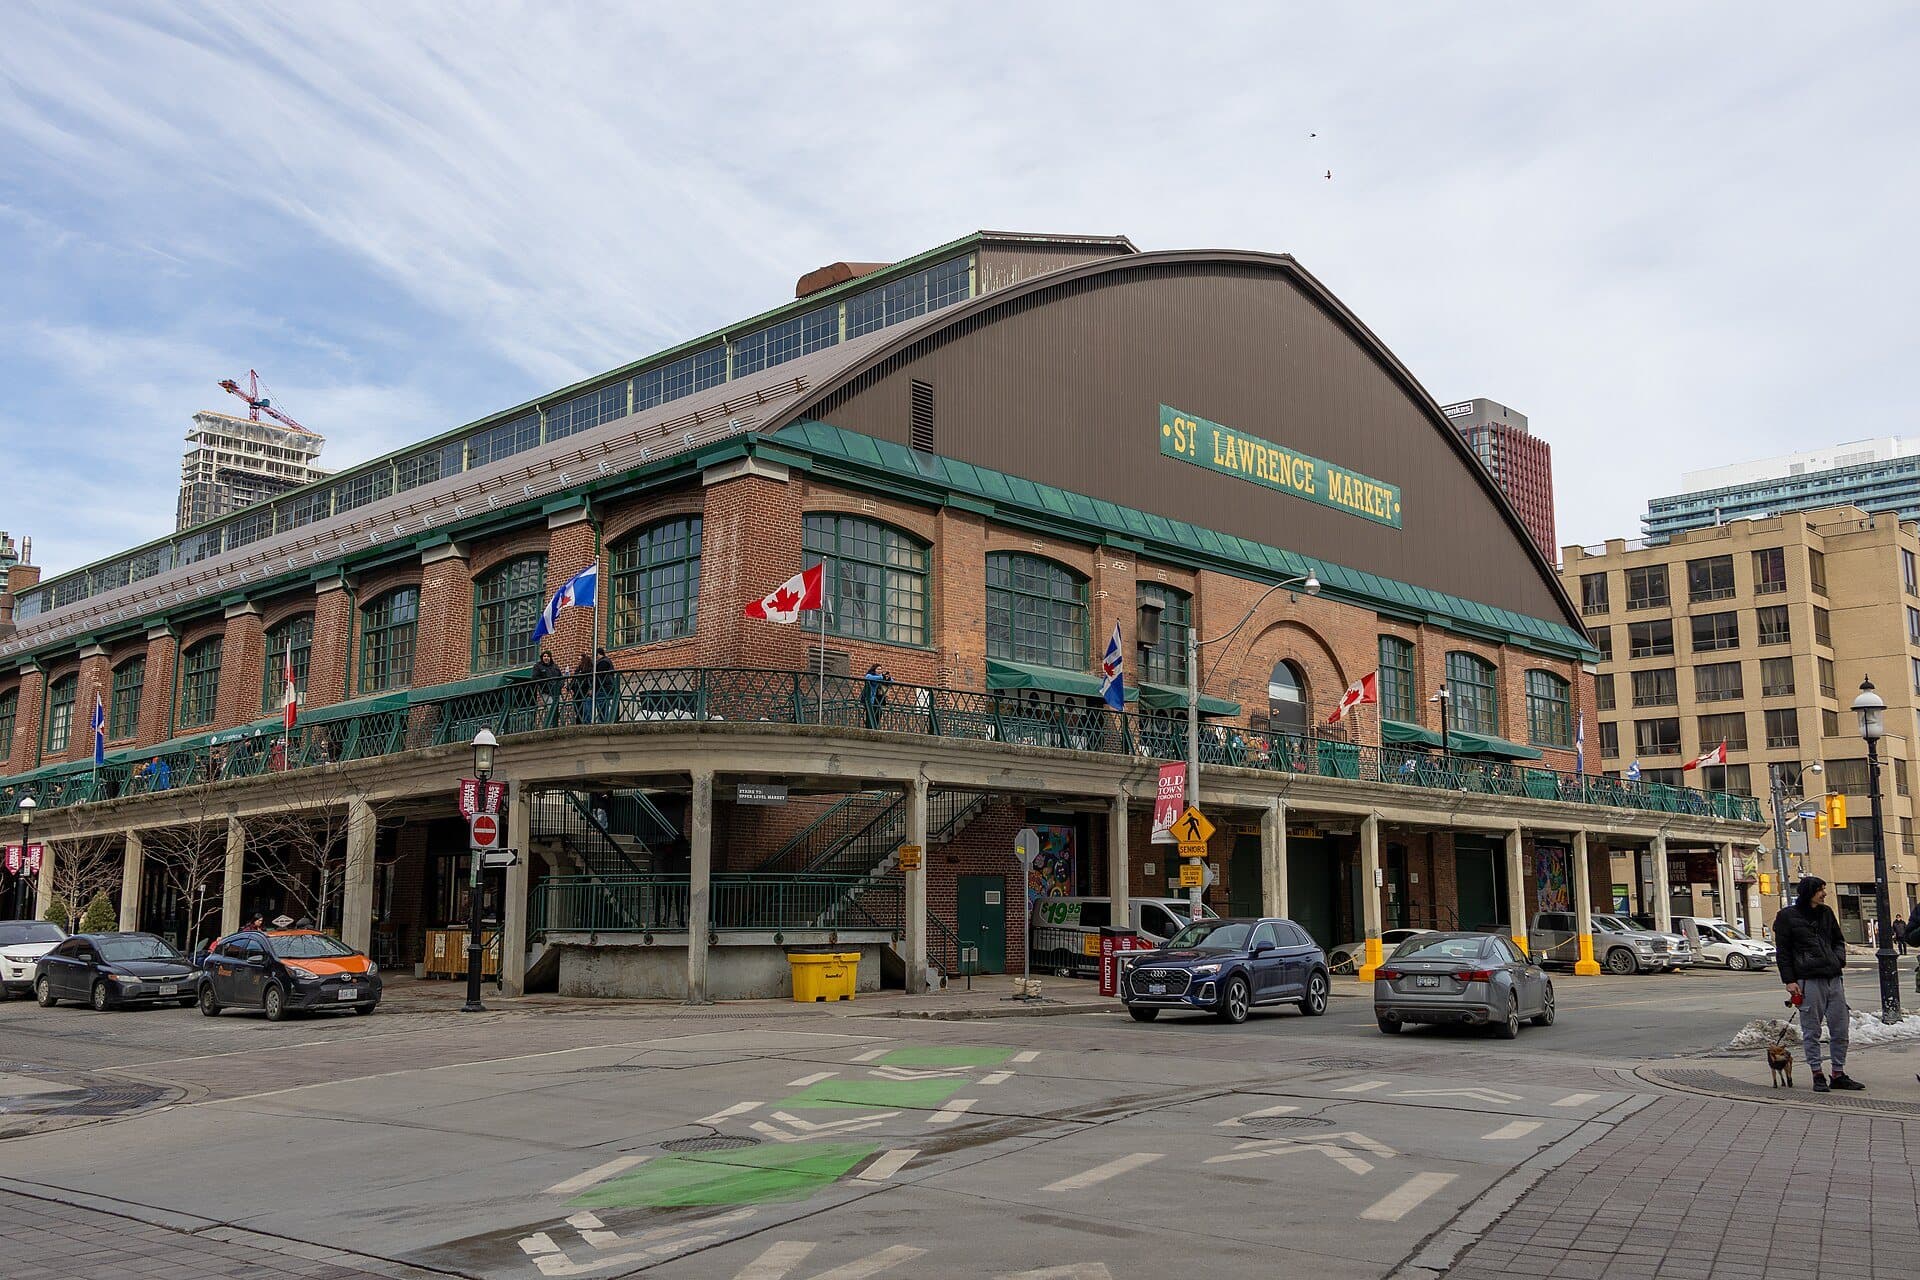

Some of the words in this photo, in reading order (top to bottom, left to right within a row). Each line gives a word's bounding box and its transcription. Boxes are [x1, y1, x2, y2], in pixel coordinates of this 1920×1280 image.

[1213, 430, 1315, 495] LAWRENCE
[1327, 469, 1393, 520] MARKET
[1158, 775, 1184, 788] OLD
[1158, 785, 1182, 795] TOWN
[1179, 845, 1206, 854] SENIORS
[1104, 957, 1112, 989] FREE
